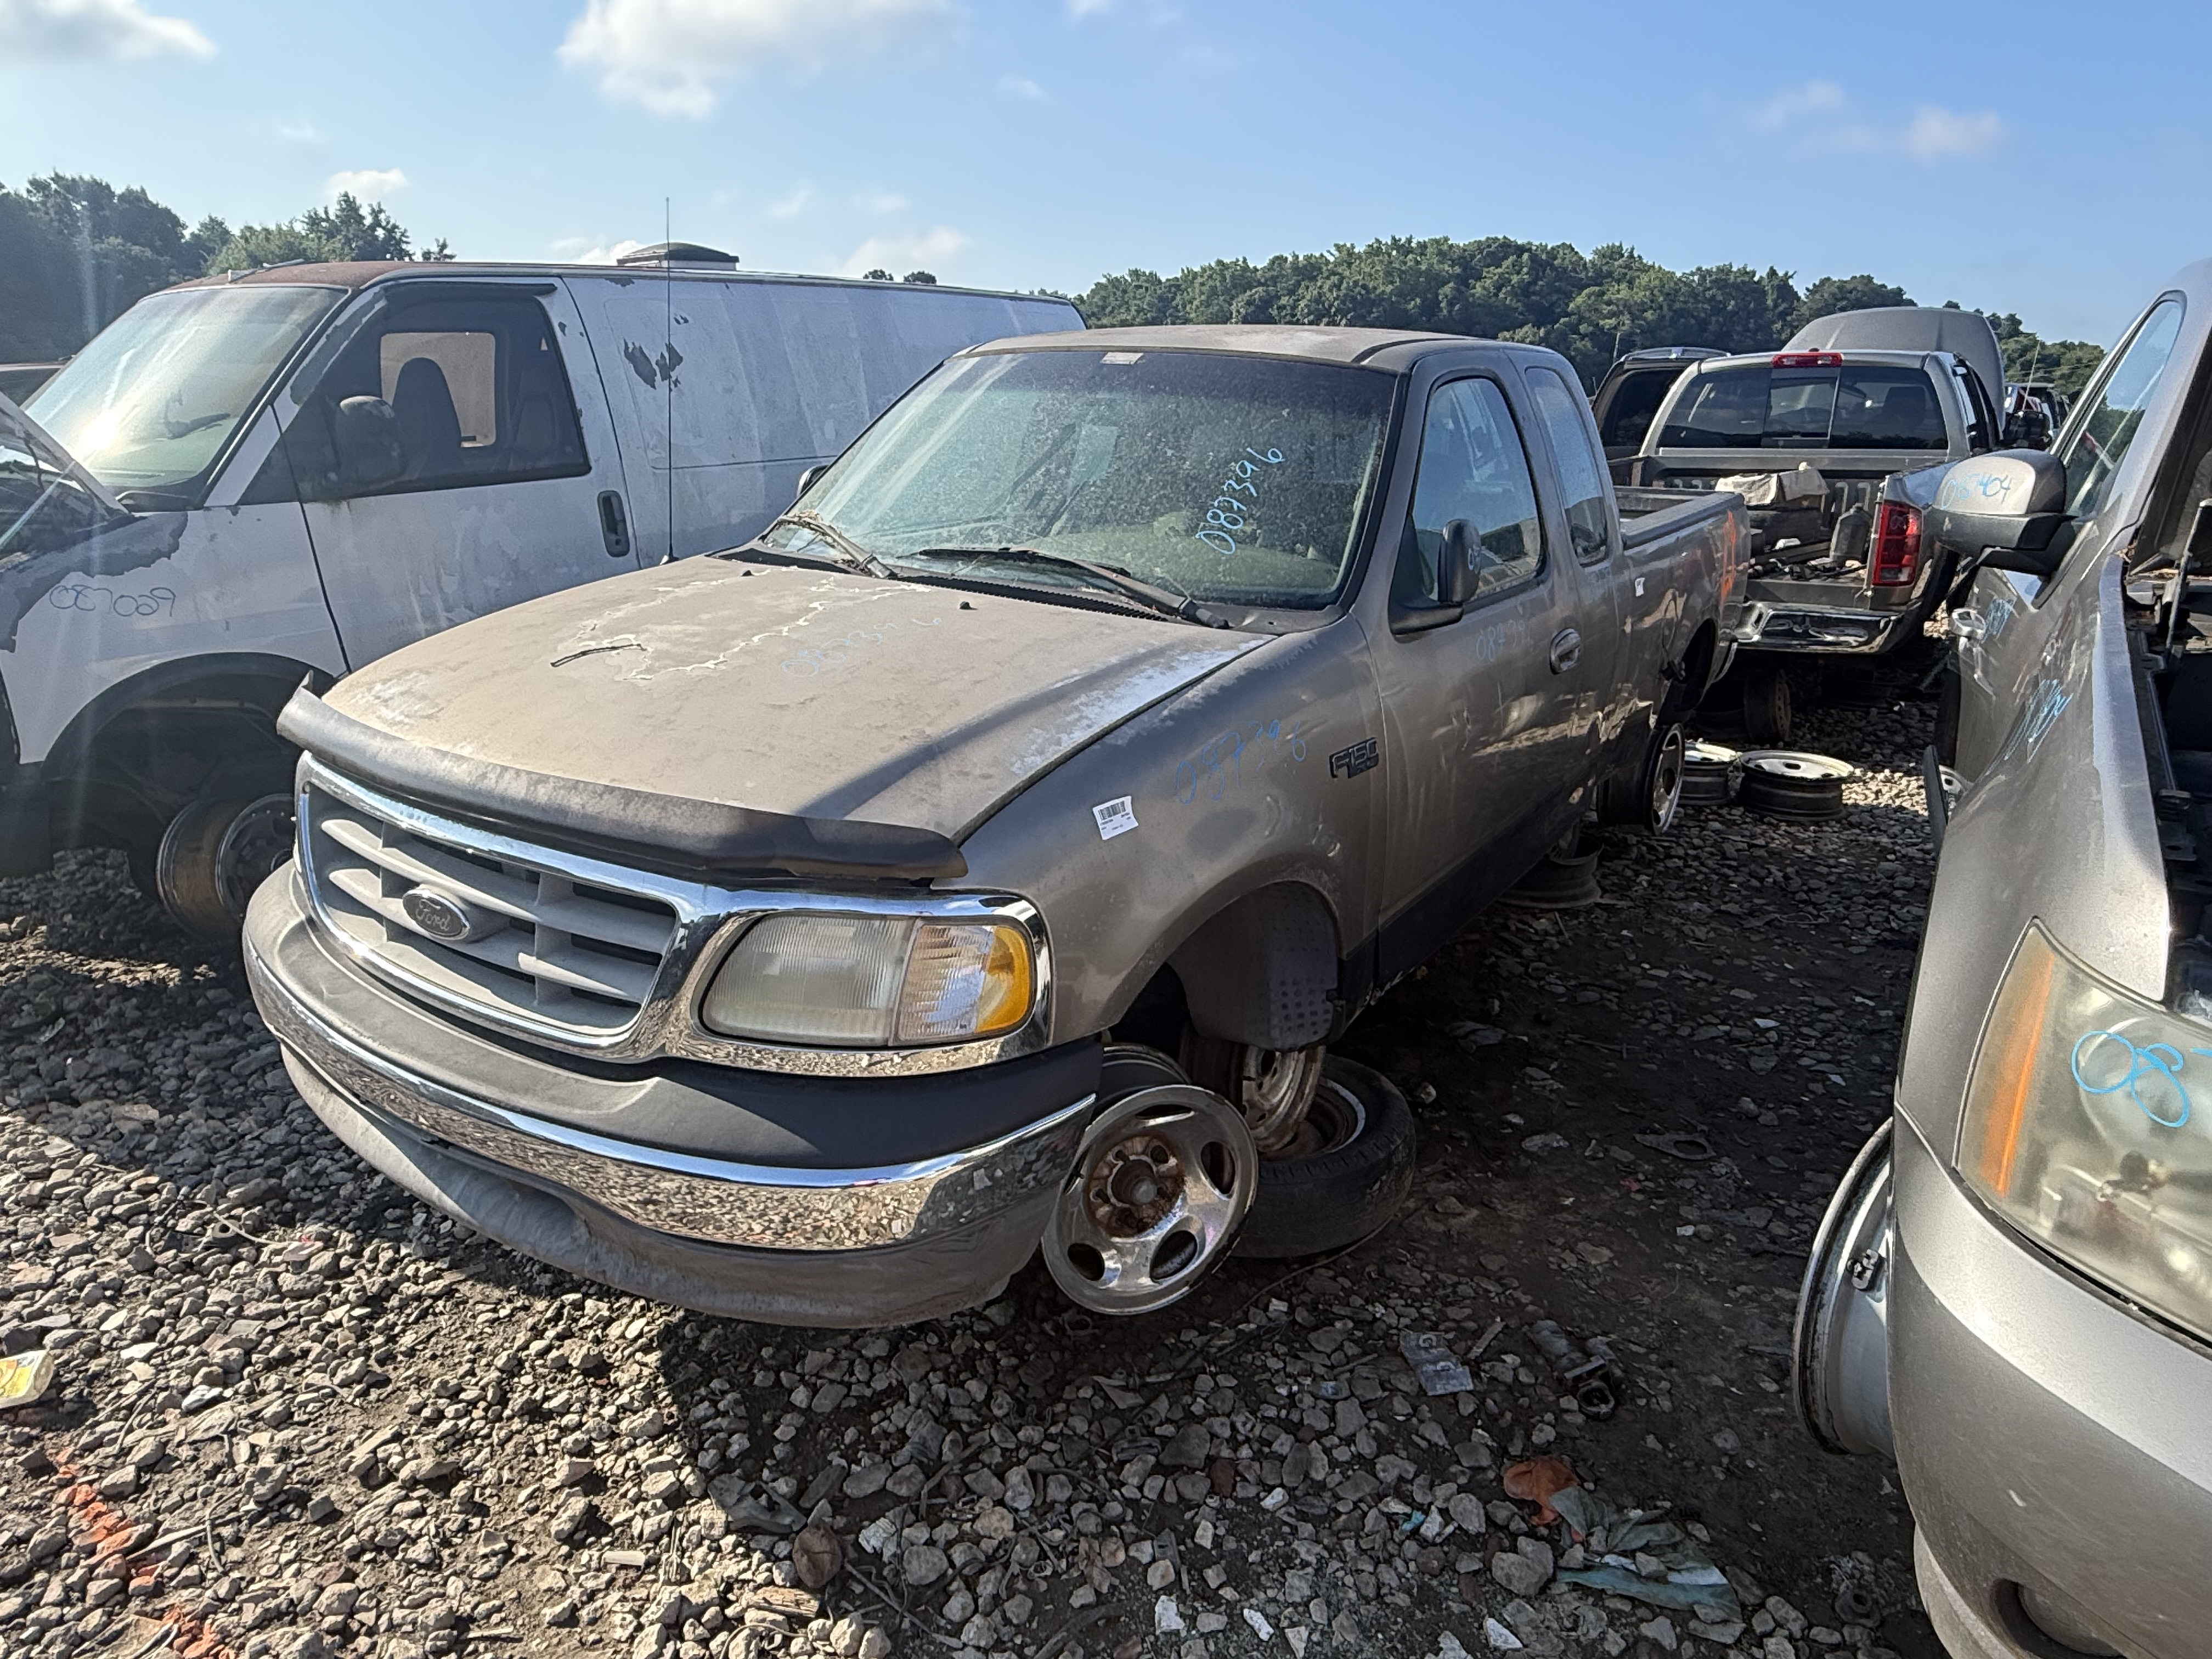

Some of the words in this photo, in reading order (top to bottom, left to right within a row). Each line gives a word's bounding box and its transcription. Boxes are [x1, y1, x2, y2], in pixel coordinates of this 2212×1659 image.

[1195, 447, 1286, 555] 087396
[49, 584, 177, 618] 087029
[1174, 718, 1308, 805] 087396
[415, 899, 452, 932] Ford
